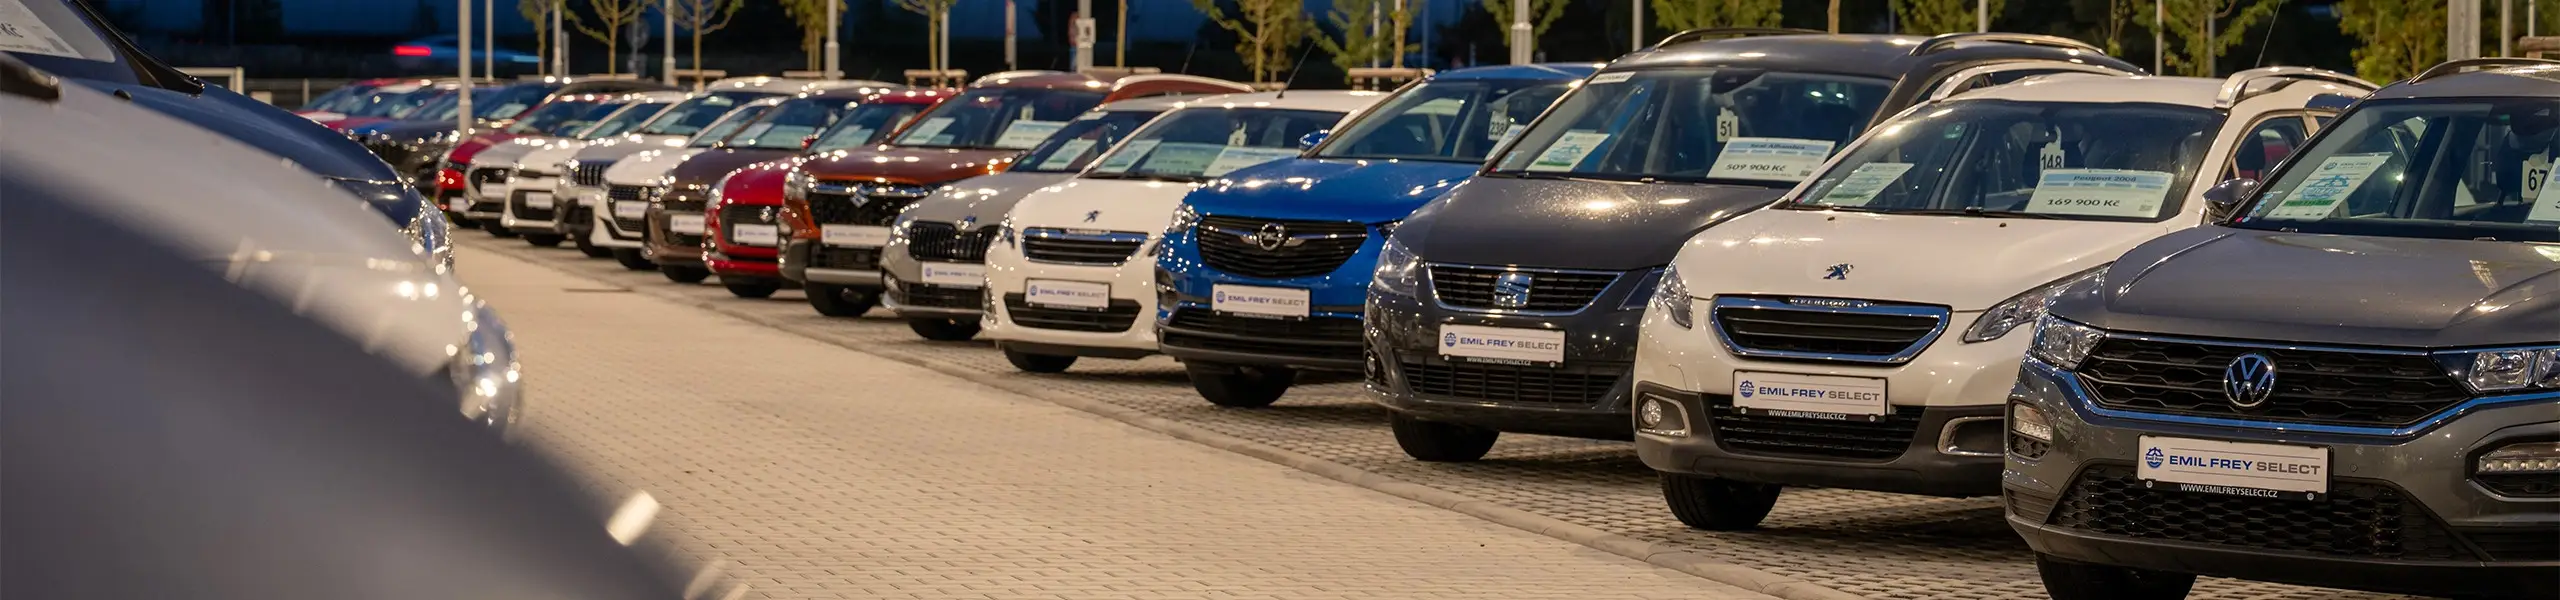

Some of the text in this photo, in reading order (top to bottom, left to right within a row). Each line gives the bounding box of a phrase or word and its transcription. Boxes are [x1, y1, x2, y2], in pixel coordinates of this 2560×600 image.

[1720, 120, 1733, 137] 51
[1725, 163, 1747, 171] 509
[1749, 164, 1770, 172] 900
[2041, 153, 2062, 169] 148
[2528, 168, 2548, 191] 67
[1248, 296, 1270, 304] FREY
[1272, 298, 1305, 306] SELECT
[1460, 337, 1485, 346] EMIL
[1487, 339, 1515, 347] FREY
[1517, 341, 1560, 350] SELECT
[1759, 386, 1789, 396] EMIL
[1791, 388, 1826, 398] FREY
[1828, 390, 1880, 401] SELECT
[1768, 409, 1847, 421] WWW.EMILFREYSELECT.CZ
[2169, 455, 2320, 475] EMIL FREY SELECT
[2180, 483, 2278, 498] WWW.EMILFREYSELECT.CZ
